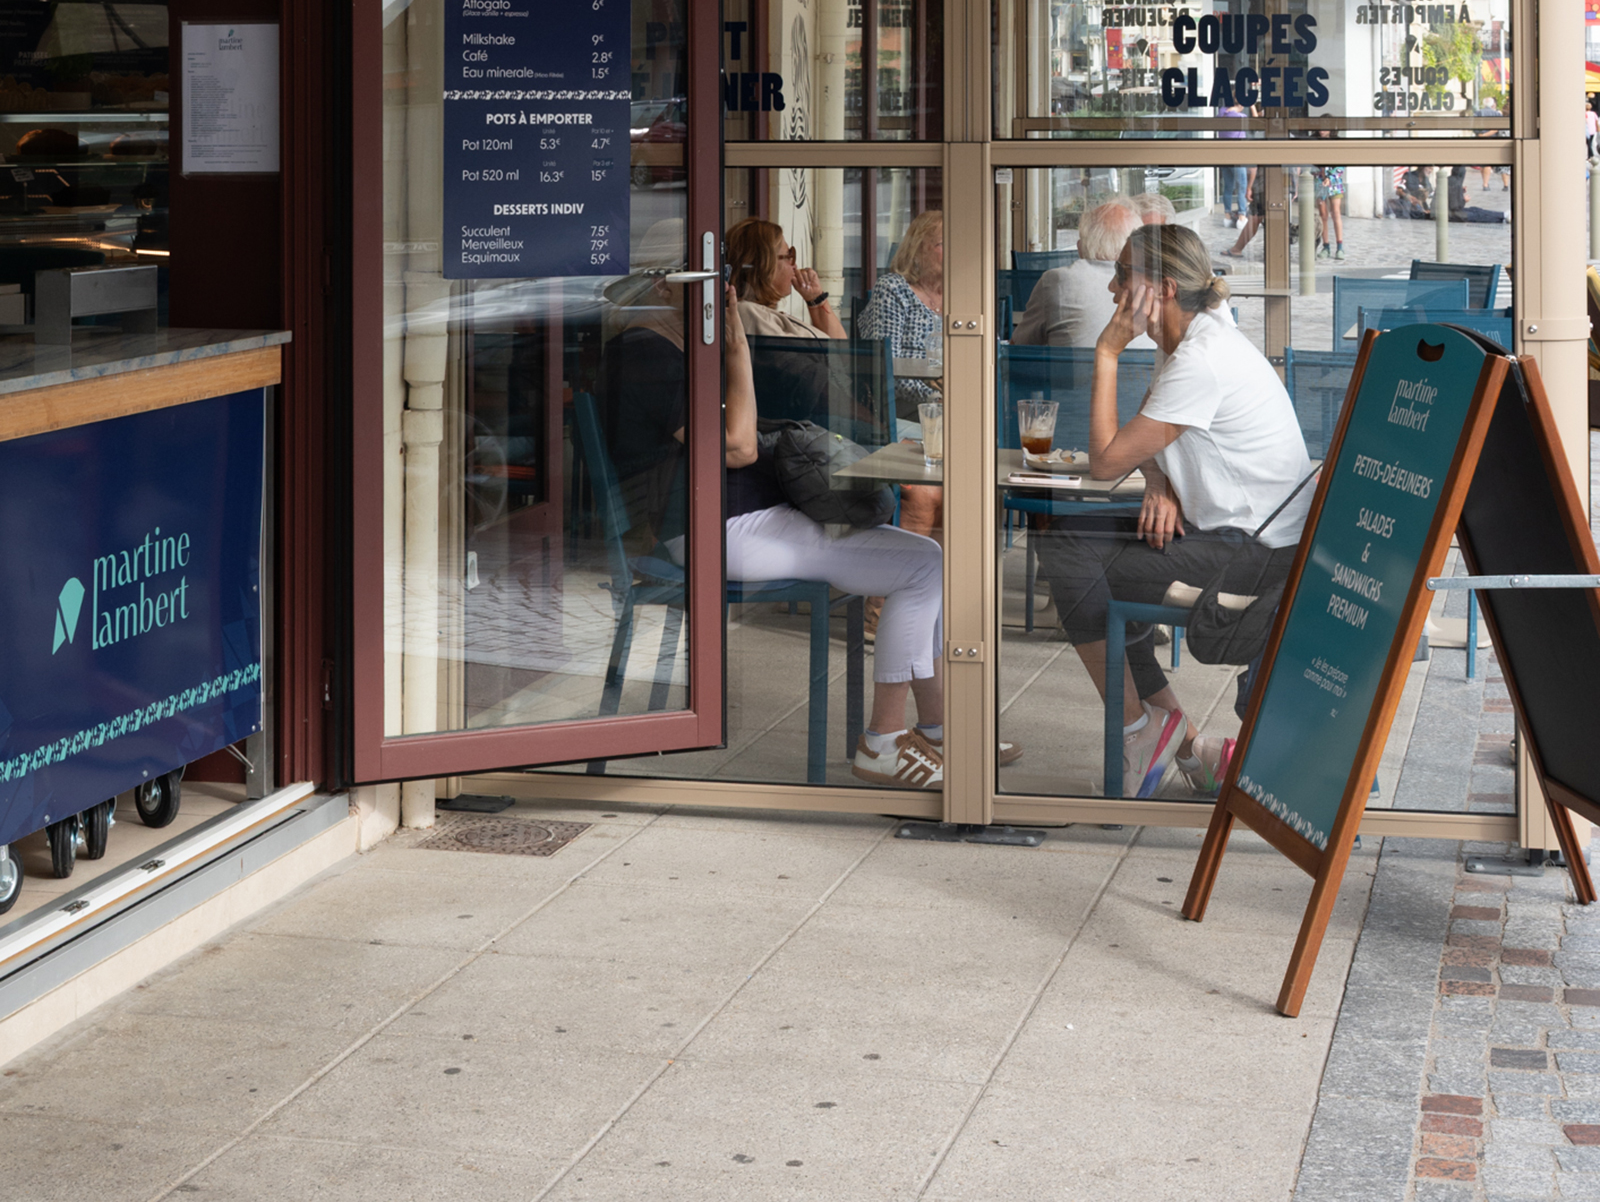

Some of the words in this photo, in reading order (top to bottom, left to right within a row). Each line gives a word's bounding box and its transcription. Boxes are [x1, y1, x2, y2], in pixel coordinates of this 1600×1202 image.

[593, 0, 604, 11] 6€
[463, 34, 515, 45] Milkshake
[592, 35, 604, 45] 9€
[1173, 14, 1317, 54] COUPES
[463, 50, 488, 61] Café
[592, 52, 613, 63] 2.8€
[463, 68, 483, 78] Eau
[486, 67, 534, 78] minerale
[592, 68, 609, 79] 1.5€
[1161, 58, 1329, 108] GLACÉES
[486, 113, 516, 124] POTS
[519, 111, 527, 124] À
[530, 114, 593, 124] EMPORTER
[463, 140, 479, 150] Pot
[482, 139, 512, 150] 120ml
[540, 138, 560, 150] 5.3€
[592, 138, 610, 149] 4.7€
[463, 170, 479, 181] Pot
[482, 170, 503, 181] 520
[506, 170, 519, 180] ml
[540, 171, 564, 182] 16.3€
[592, 171, 606, 181] 15€
[494, 204, 548, 215] DESSERTS
[551, 203, 584, 214] INDIV
[462, 226, 510, 237] Succulent
[462, 239, 523, 250] Merveilleux
[462, 252, 520, 265] Esquimaux
[591, 253, 610, 265] 5.9€
[1396, 378, 1438, 405] martine
[1387, 401, 1431, 432] lambert
[1353, 454, 1434, 499] PETITS-DÉJEUNERS
[1356, 507, 1396, 539] SALADES
[93, 526, 191, 592] martine
[1361, 542, 1371, 564] &
[1331, 562, 1384, 602] SANDWICHS
[92, 575, 190, 651] lambert
[1326, 593, 1369, 630] PREMIUM
